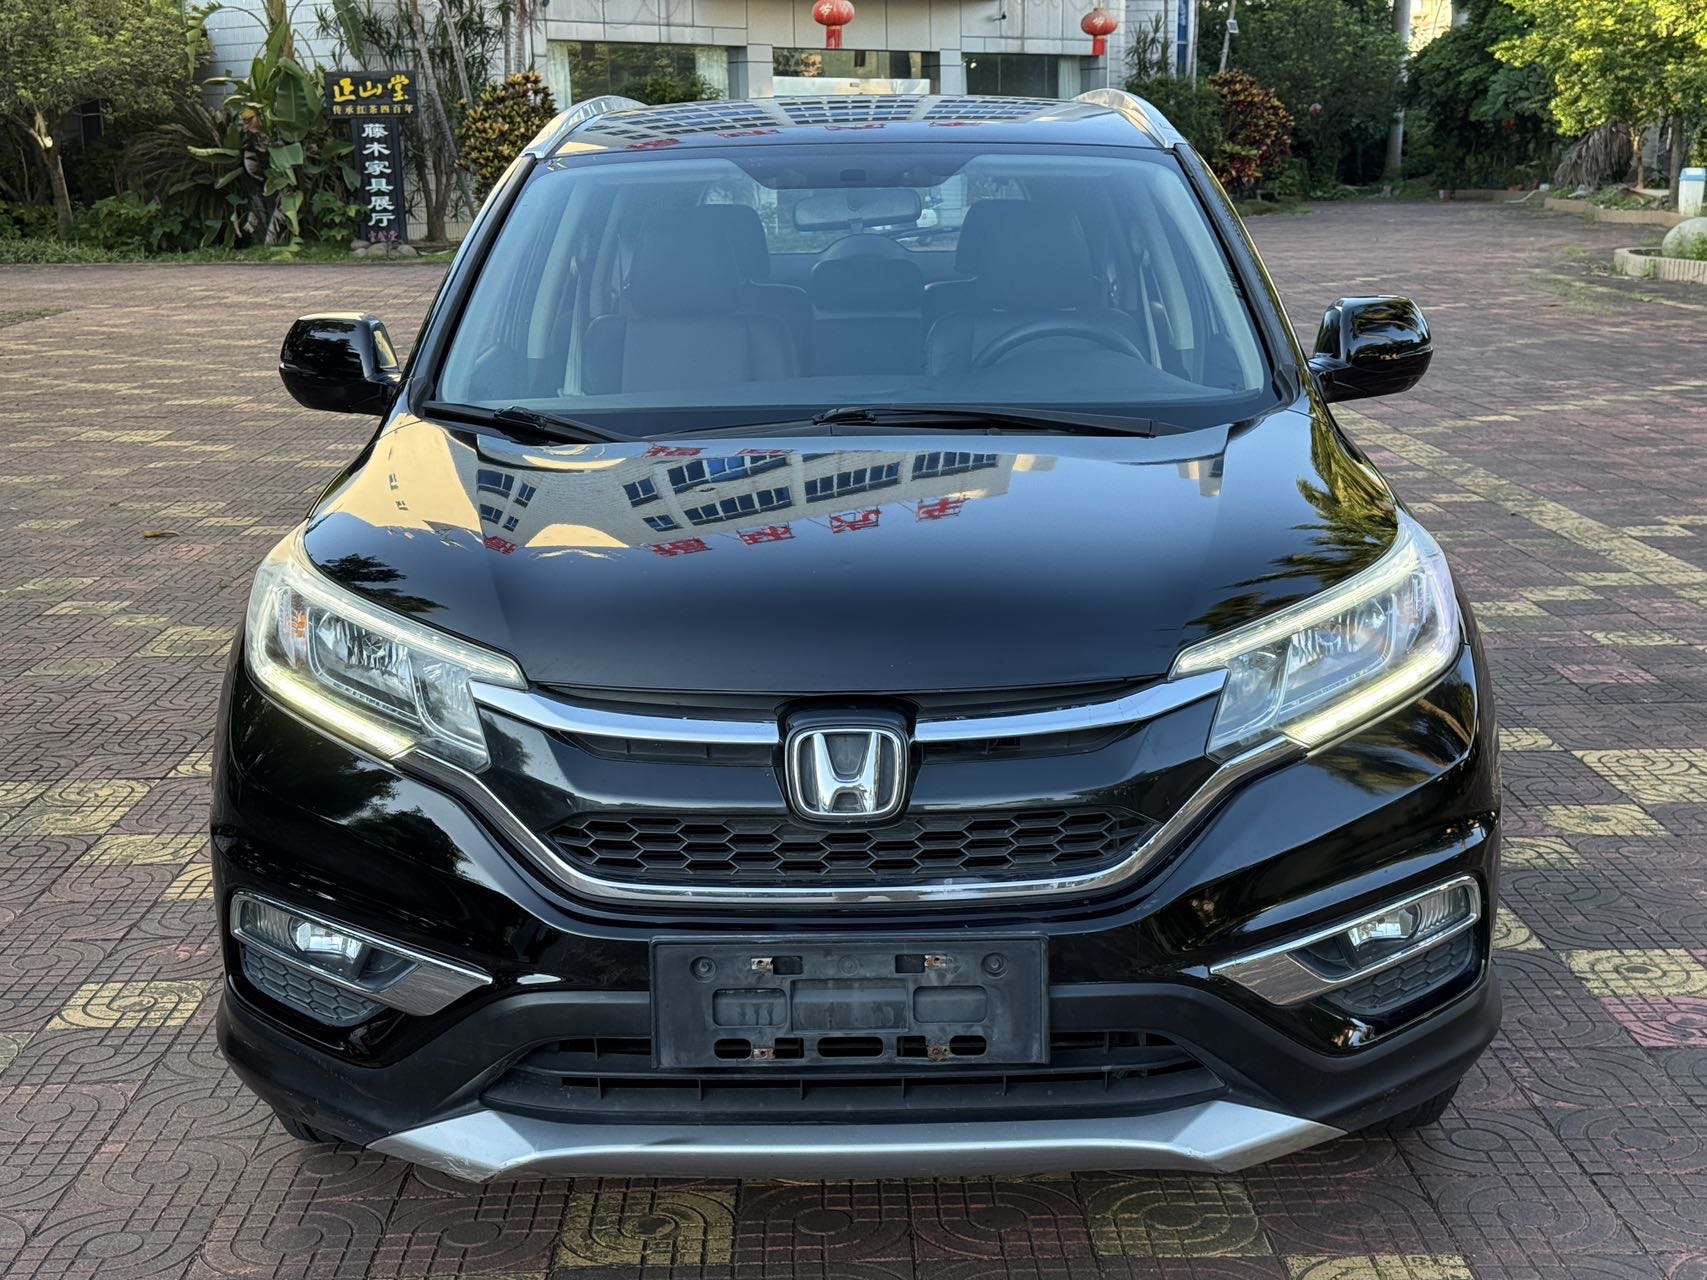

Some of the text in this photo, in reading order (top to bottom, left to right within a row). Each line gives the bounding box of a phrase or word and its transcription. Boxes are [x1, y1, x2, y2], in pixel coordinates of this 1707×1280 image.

[333, 74, 410, 102] 正山堂
[333, 104, 414, 115] 传承红茶四百年
[361, 123, 396, 227] 藤木家具展厅
